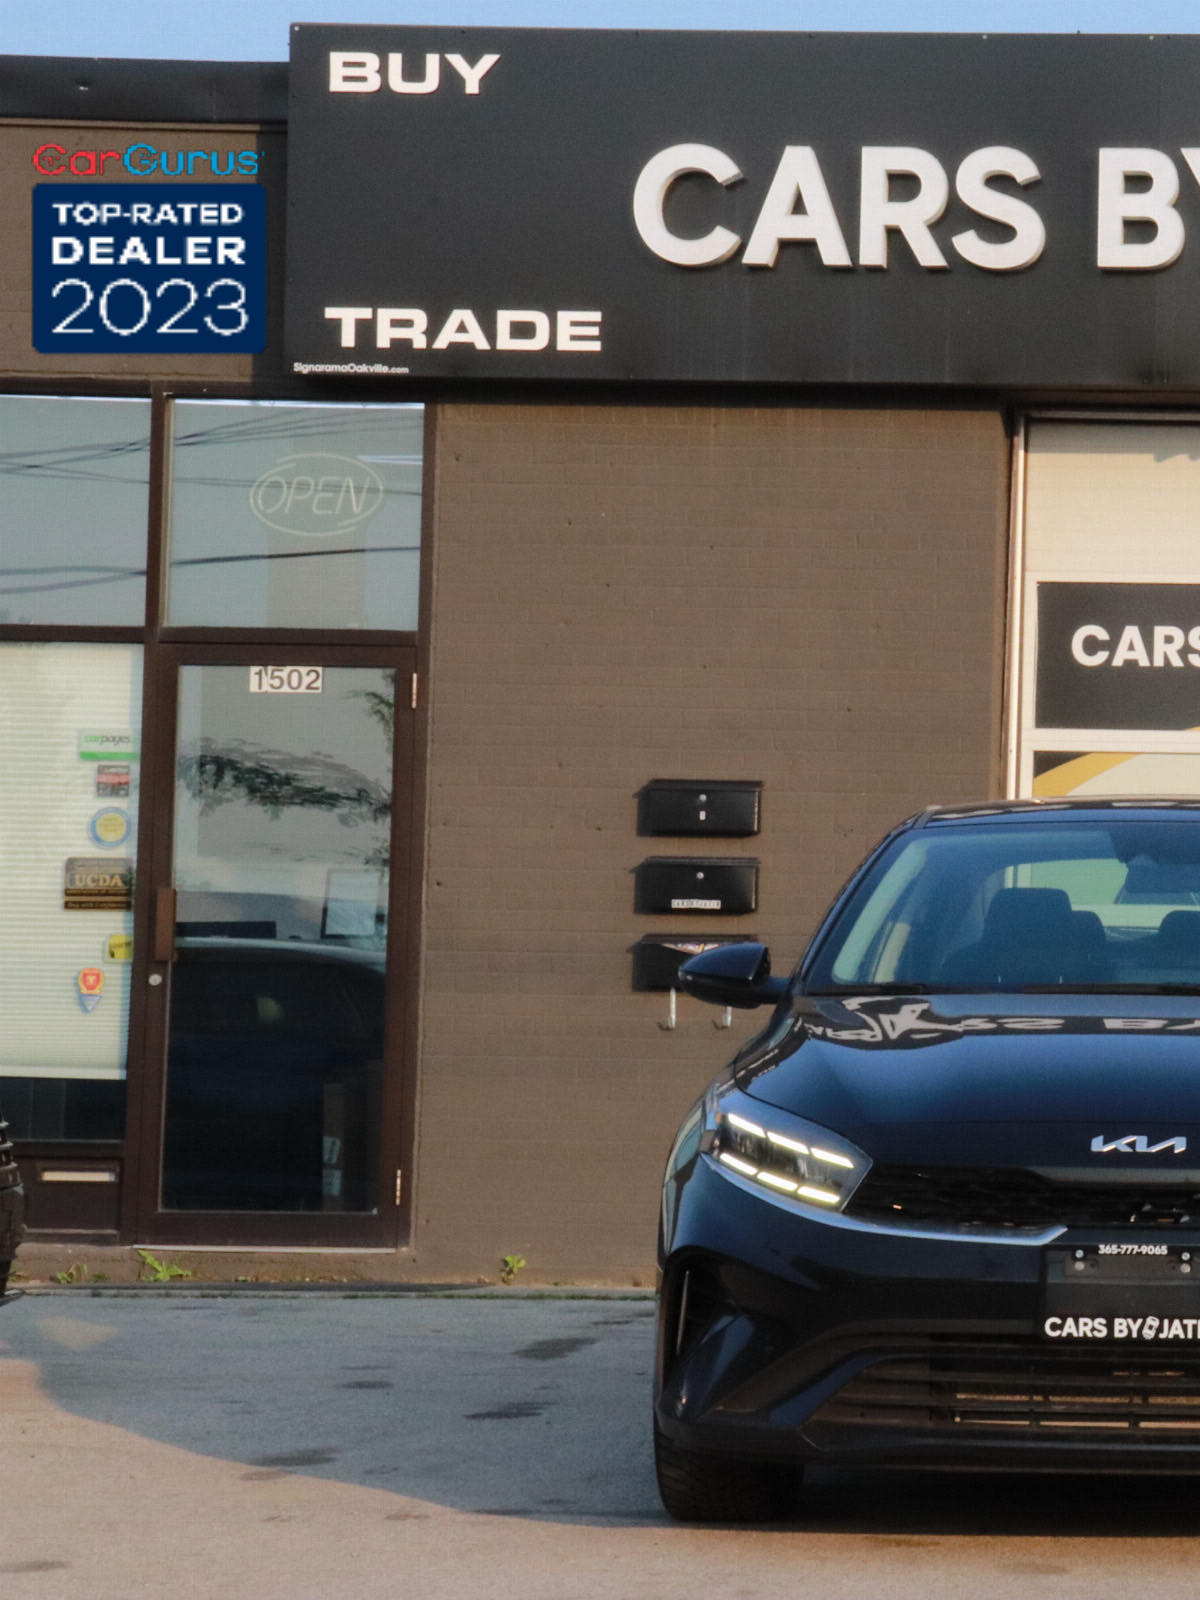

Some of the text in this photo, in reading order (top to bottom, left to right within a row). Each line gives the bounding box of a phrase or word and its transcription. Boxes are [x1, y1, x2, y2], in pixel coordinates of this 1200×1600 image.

[328, 51, 501, 95] BUY
[632, 142, 1047, 271] CARS
[324, 307, 603, 352] TRADE
[292, 361, 410, 375] SignaramaOakville.com
[256, 474, 370, 516] OPEN
[254, 669, 320, 690] 1502
[74, 874, 123, 888] UCDA
[1090, 1135, 1187, 1154] KIA
[1098, 1244, 1168, 1256] 365-777-9065
[1044, 1316, 1108, 1338] CARS
[1113, 1317, 1144, 1338] BY
